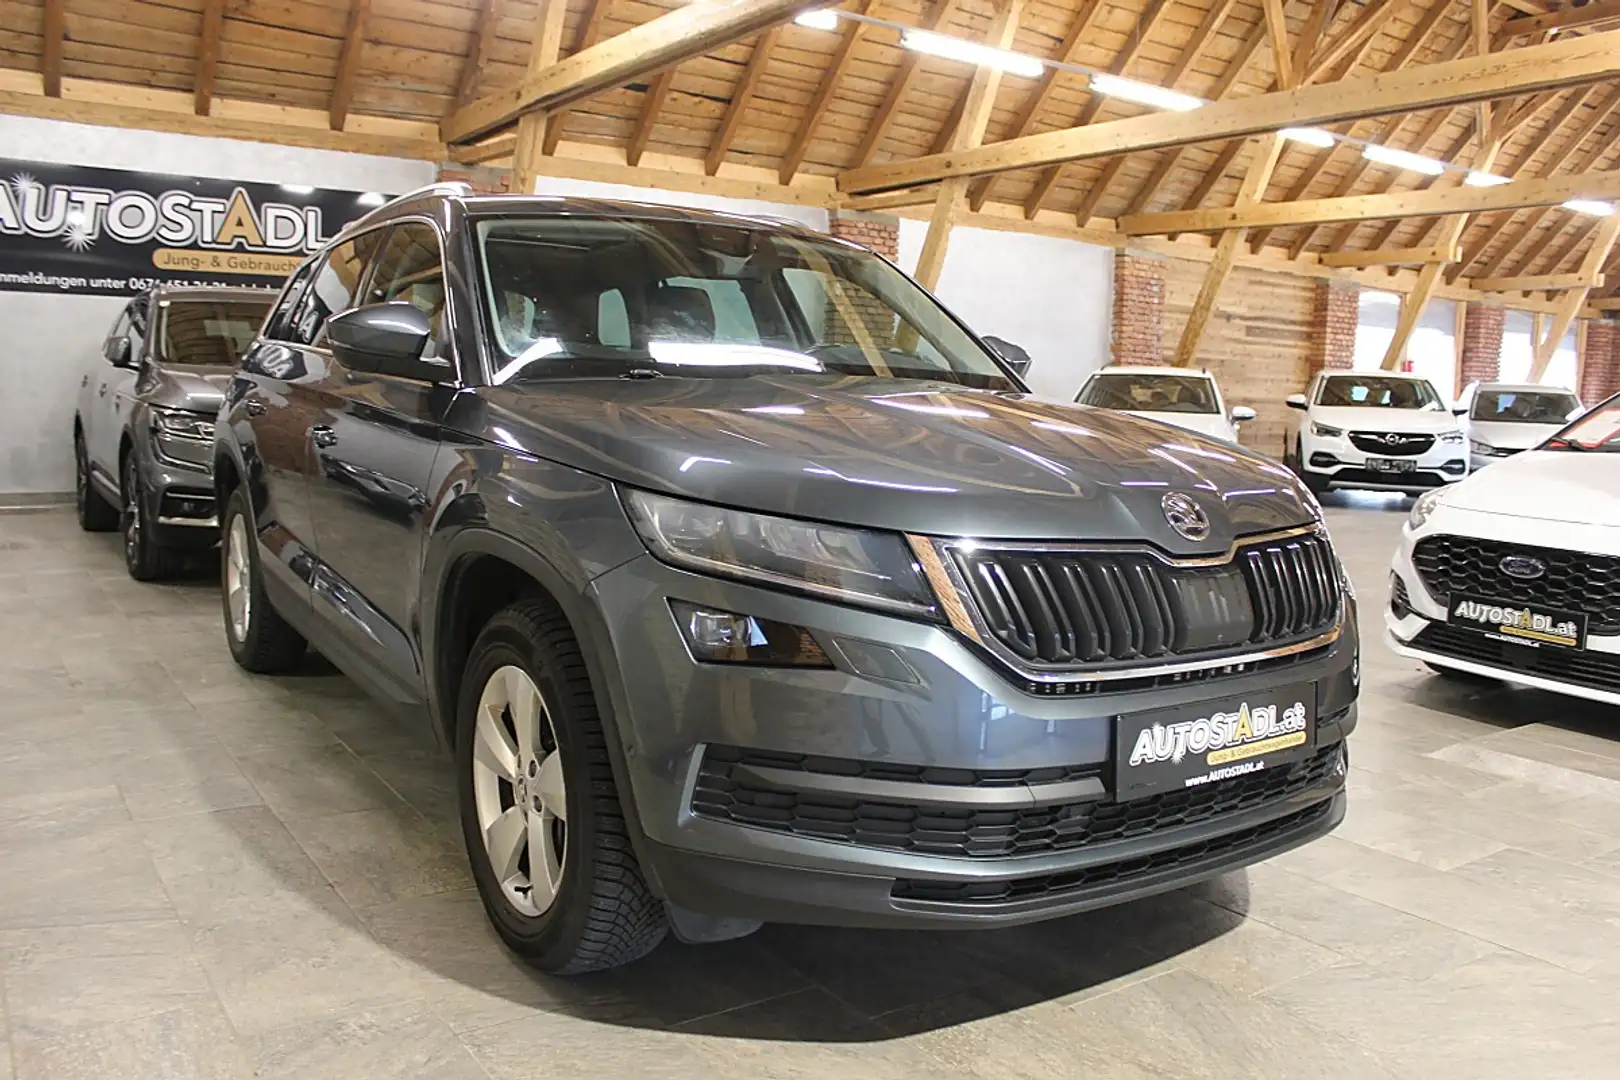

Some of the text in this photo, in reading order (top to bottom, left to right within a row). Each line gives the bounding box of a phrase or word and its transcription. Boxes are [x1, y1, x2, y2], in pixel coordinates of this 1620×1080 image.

[163, 252, 300, 272] Jung- & Gebrauch
[90, 278, 126, 289] unter
[1454, 601, 1577, 637] AUTOSTADL.at
[1129, 702, 1306, 766] AUTOSTADL.at
[1185, 761, 1265, 787] www.AUTOSTADL.at
